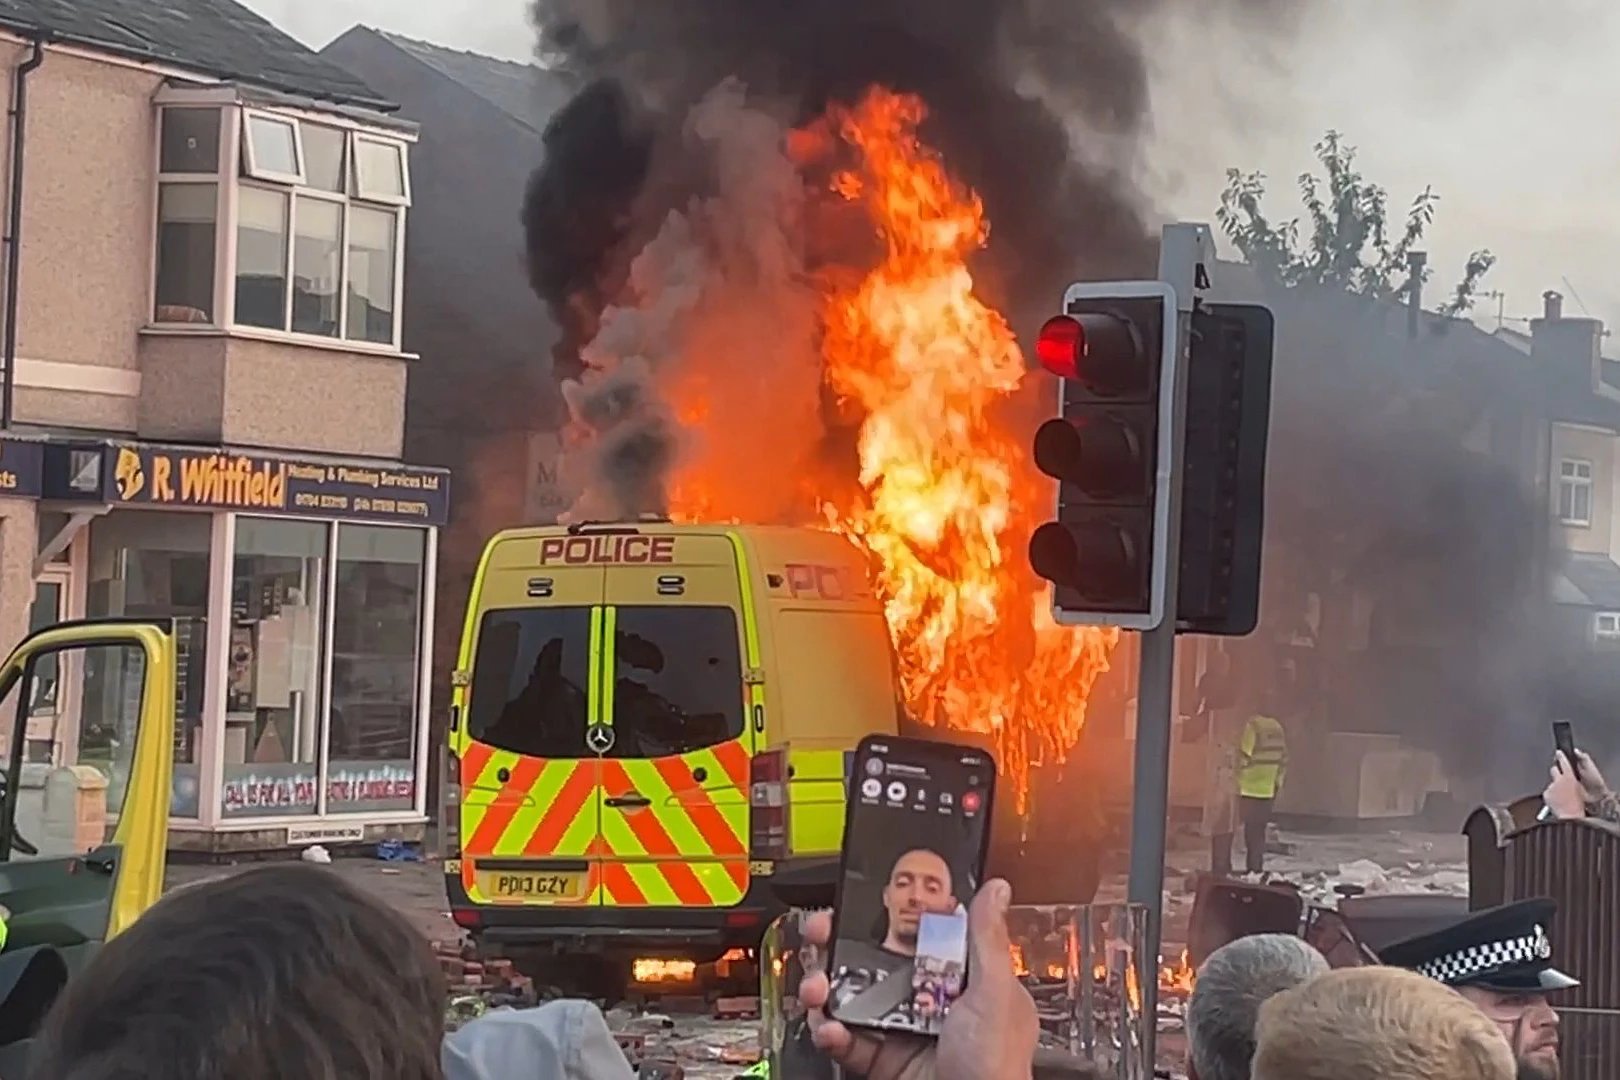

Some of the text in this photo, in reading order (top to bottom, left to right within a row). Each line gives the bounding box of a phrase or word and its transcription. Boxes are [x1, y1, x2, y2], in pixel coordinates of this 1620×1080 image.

[0, 470, 17, 489] ts
[181, 454, 286, 508] Whitfield
[381, 471, 420, 488] Services
[422, 475, 438, 490] Ltd
[540, 536, 676, 566] POLICE
[536, 876, 569, 894] GZY
